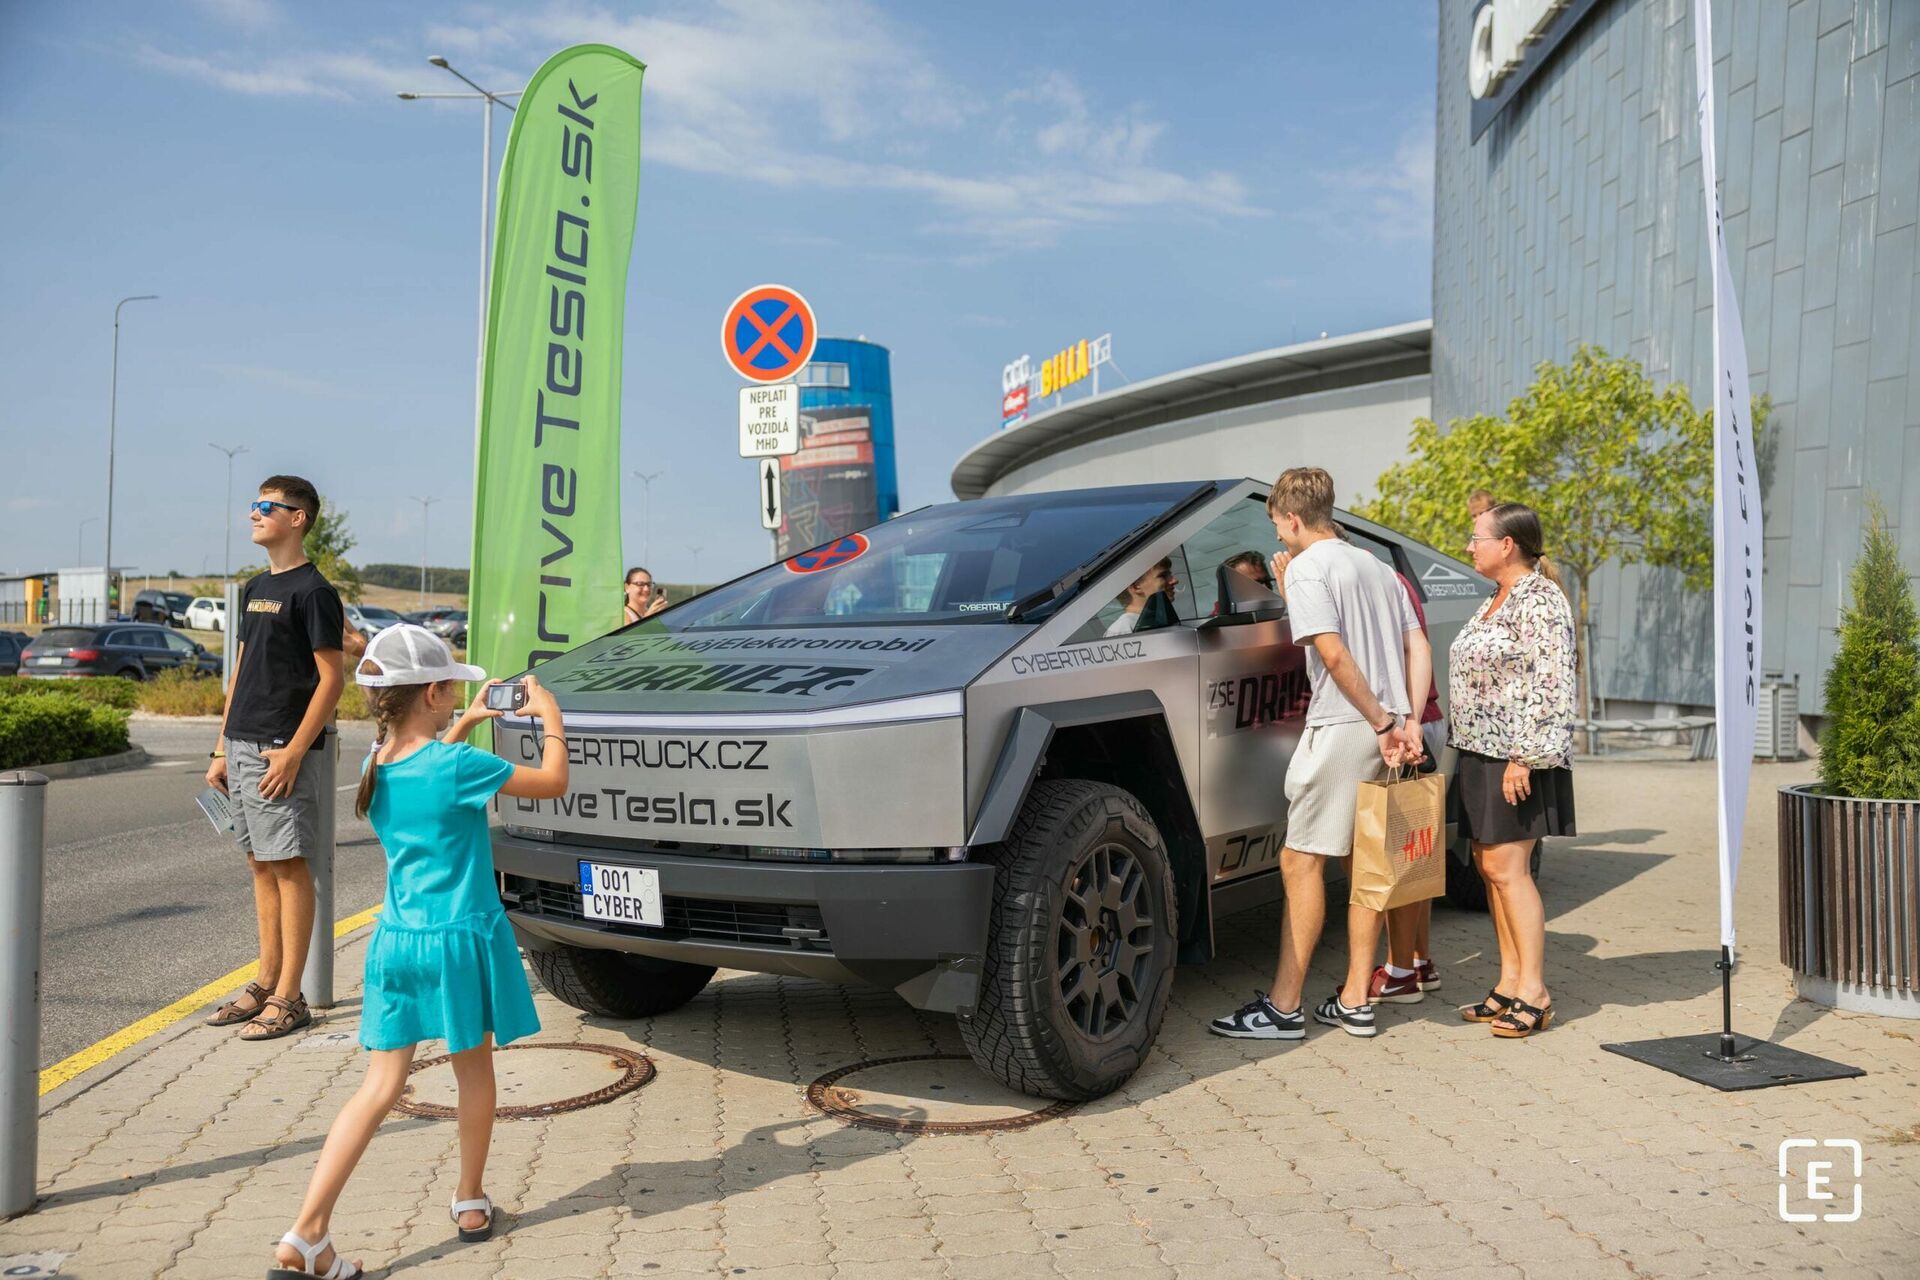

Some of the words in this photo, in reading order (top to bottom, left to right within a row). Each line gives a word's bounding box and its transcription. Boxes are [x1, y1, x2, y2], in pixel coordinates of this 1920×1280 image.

[1041, 338, 1090, 399] BILLA
[750, 387, 787, 403] NEPLATÍ
[759, 405, 777, 418] PRE
[748, 418, 789, 435] VOZIDLÁ
[755, 438, 778, 450] MHD
[959, 602, 1011, 612] CYBERTRUC
[1011, 640, 1147, 675] CYBERTRUCK.CZ
[1208, 681, 1235, 711] ZSE
[520, 734, 769, 771] CERTRUCK.CZ
[1219, 830, 1287, 874] Driv
[583, 883, 592, 892] CZ
[601, 868, 630, 892] 001
[593, 893, 643, 920] CYBER
